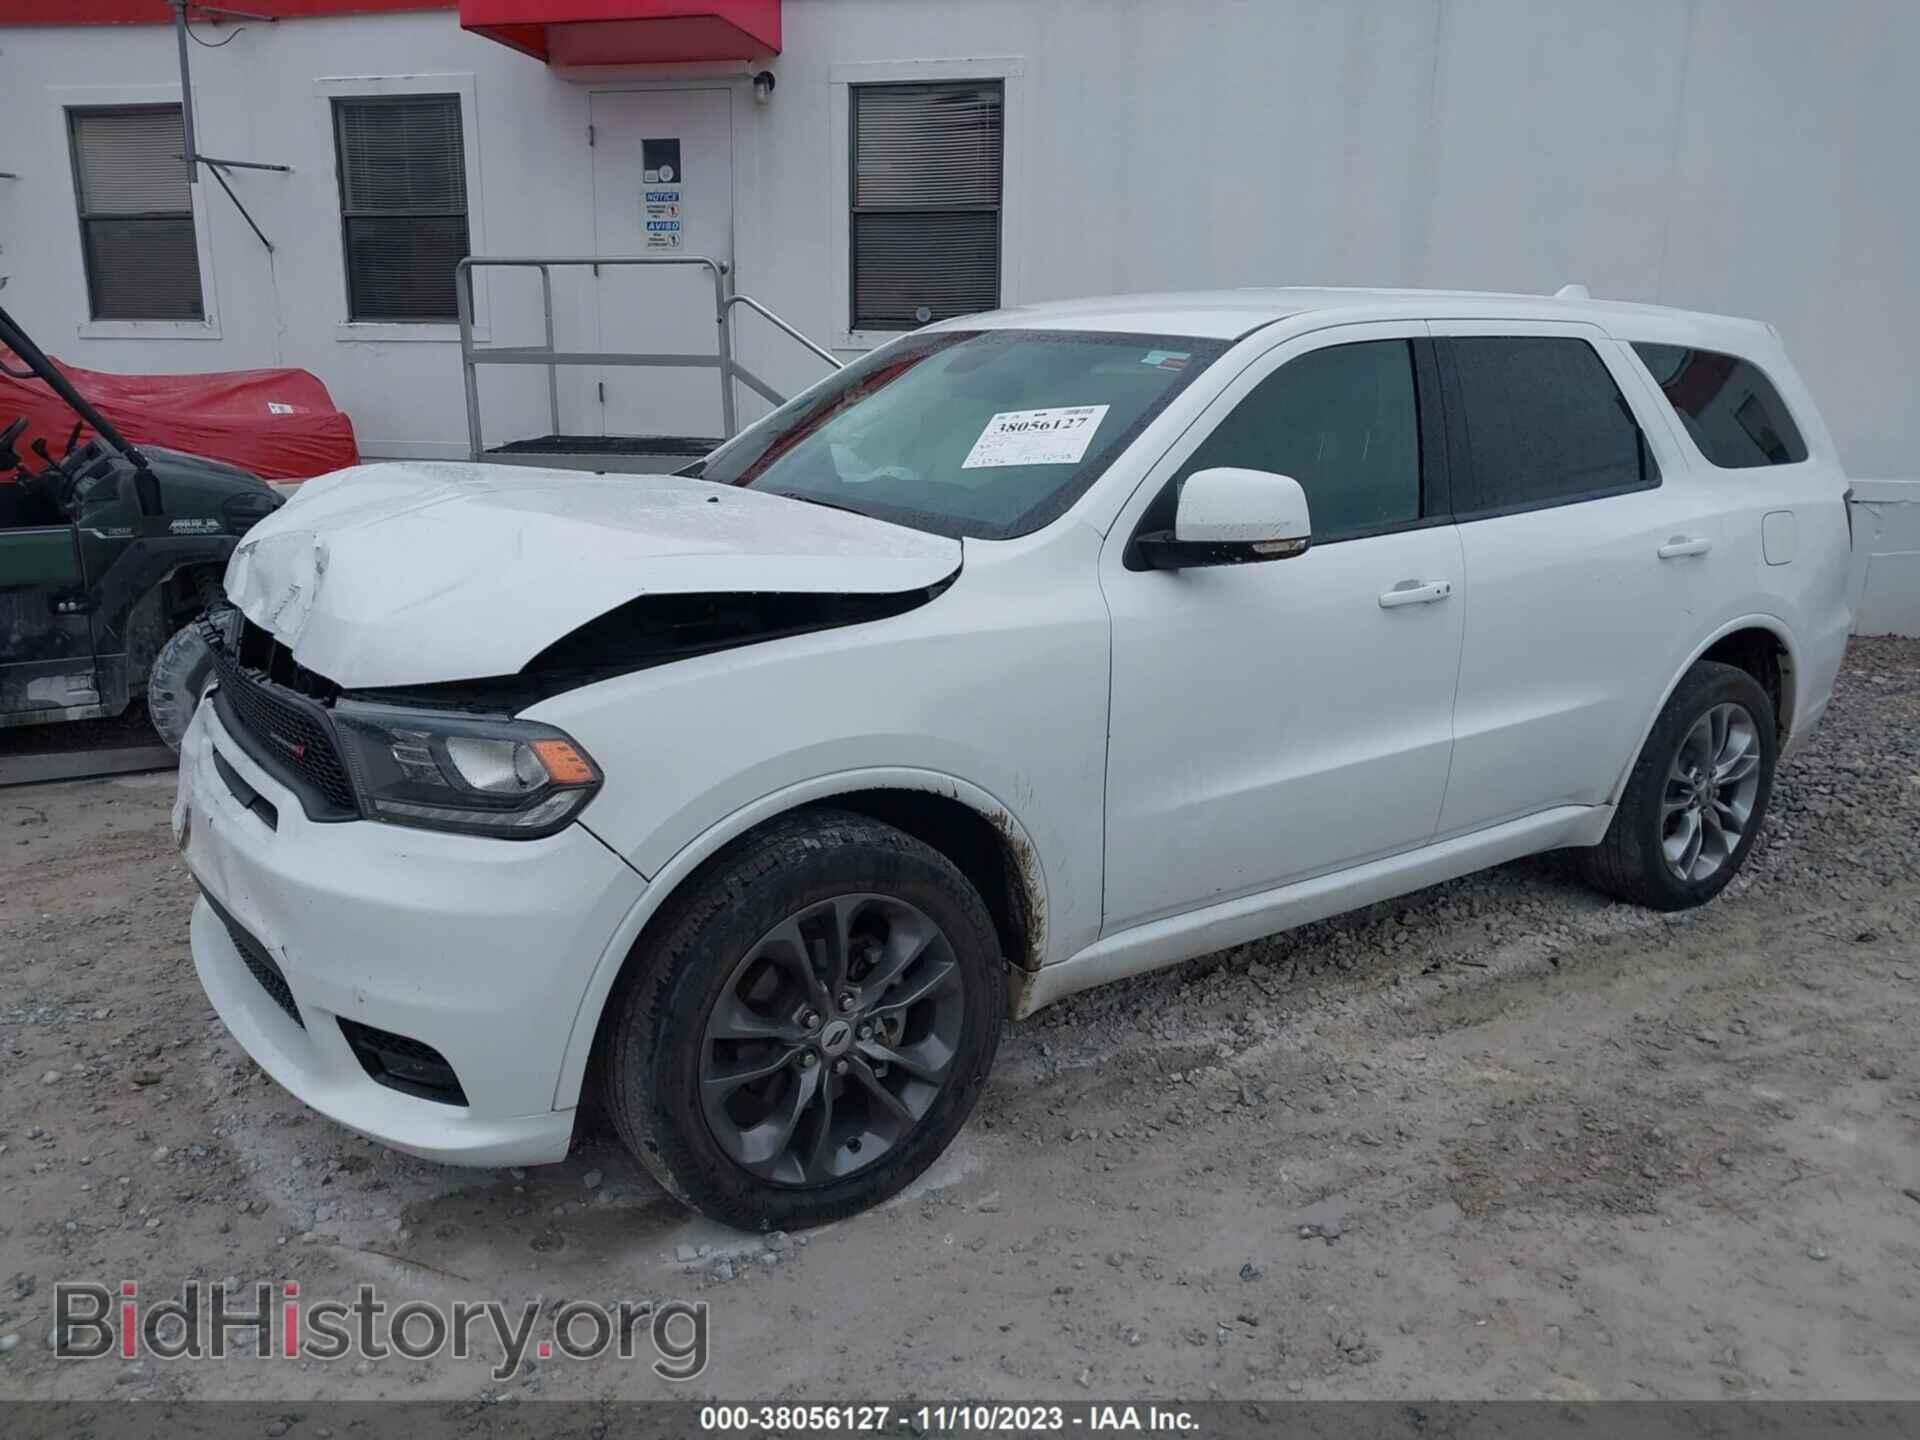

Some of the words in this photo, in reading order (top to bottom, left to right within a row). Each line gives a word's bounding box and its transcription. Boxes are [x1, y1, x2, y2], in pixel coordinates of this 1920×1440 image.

[647, 192, 678, 201] NOTICE
[648, 222, 679, 231] AVISO
[993, 416, 1089, 434] 38056127
